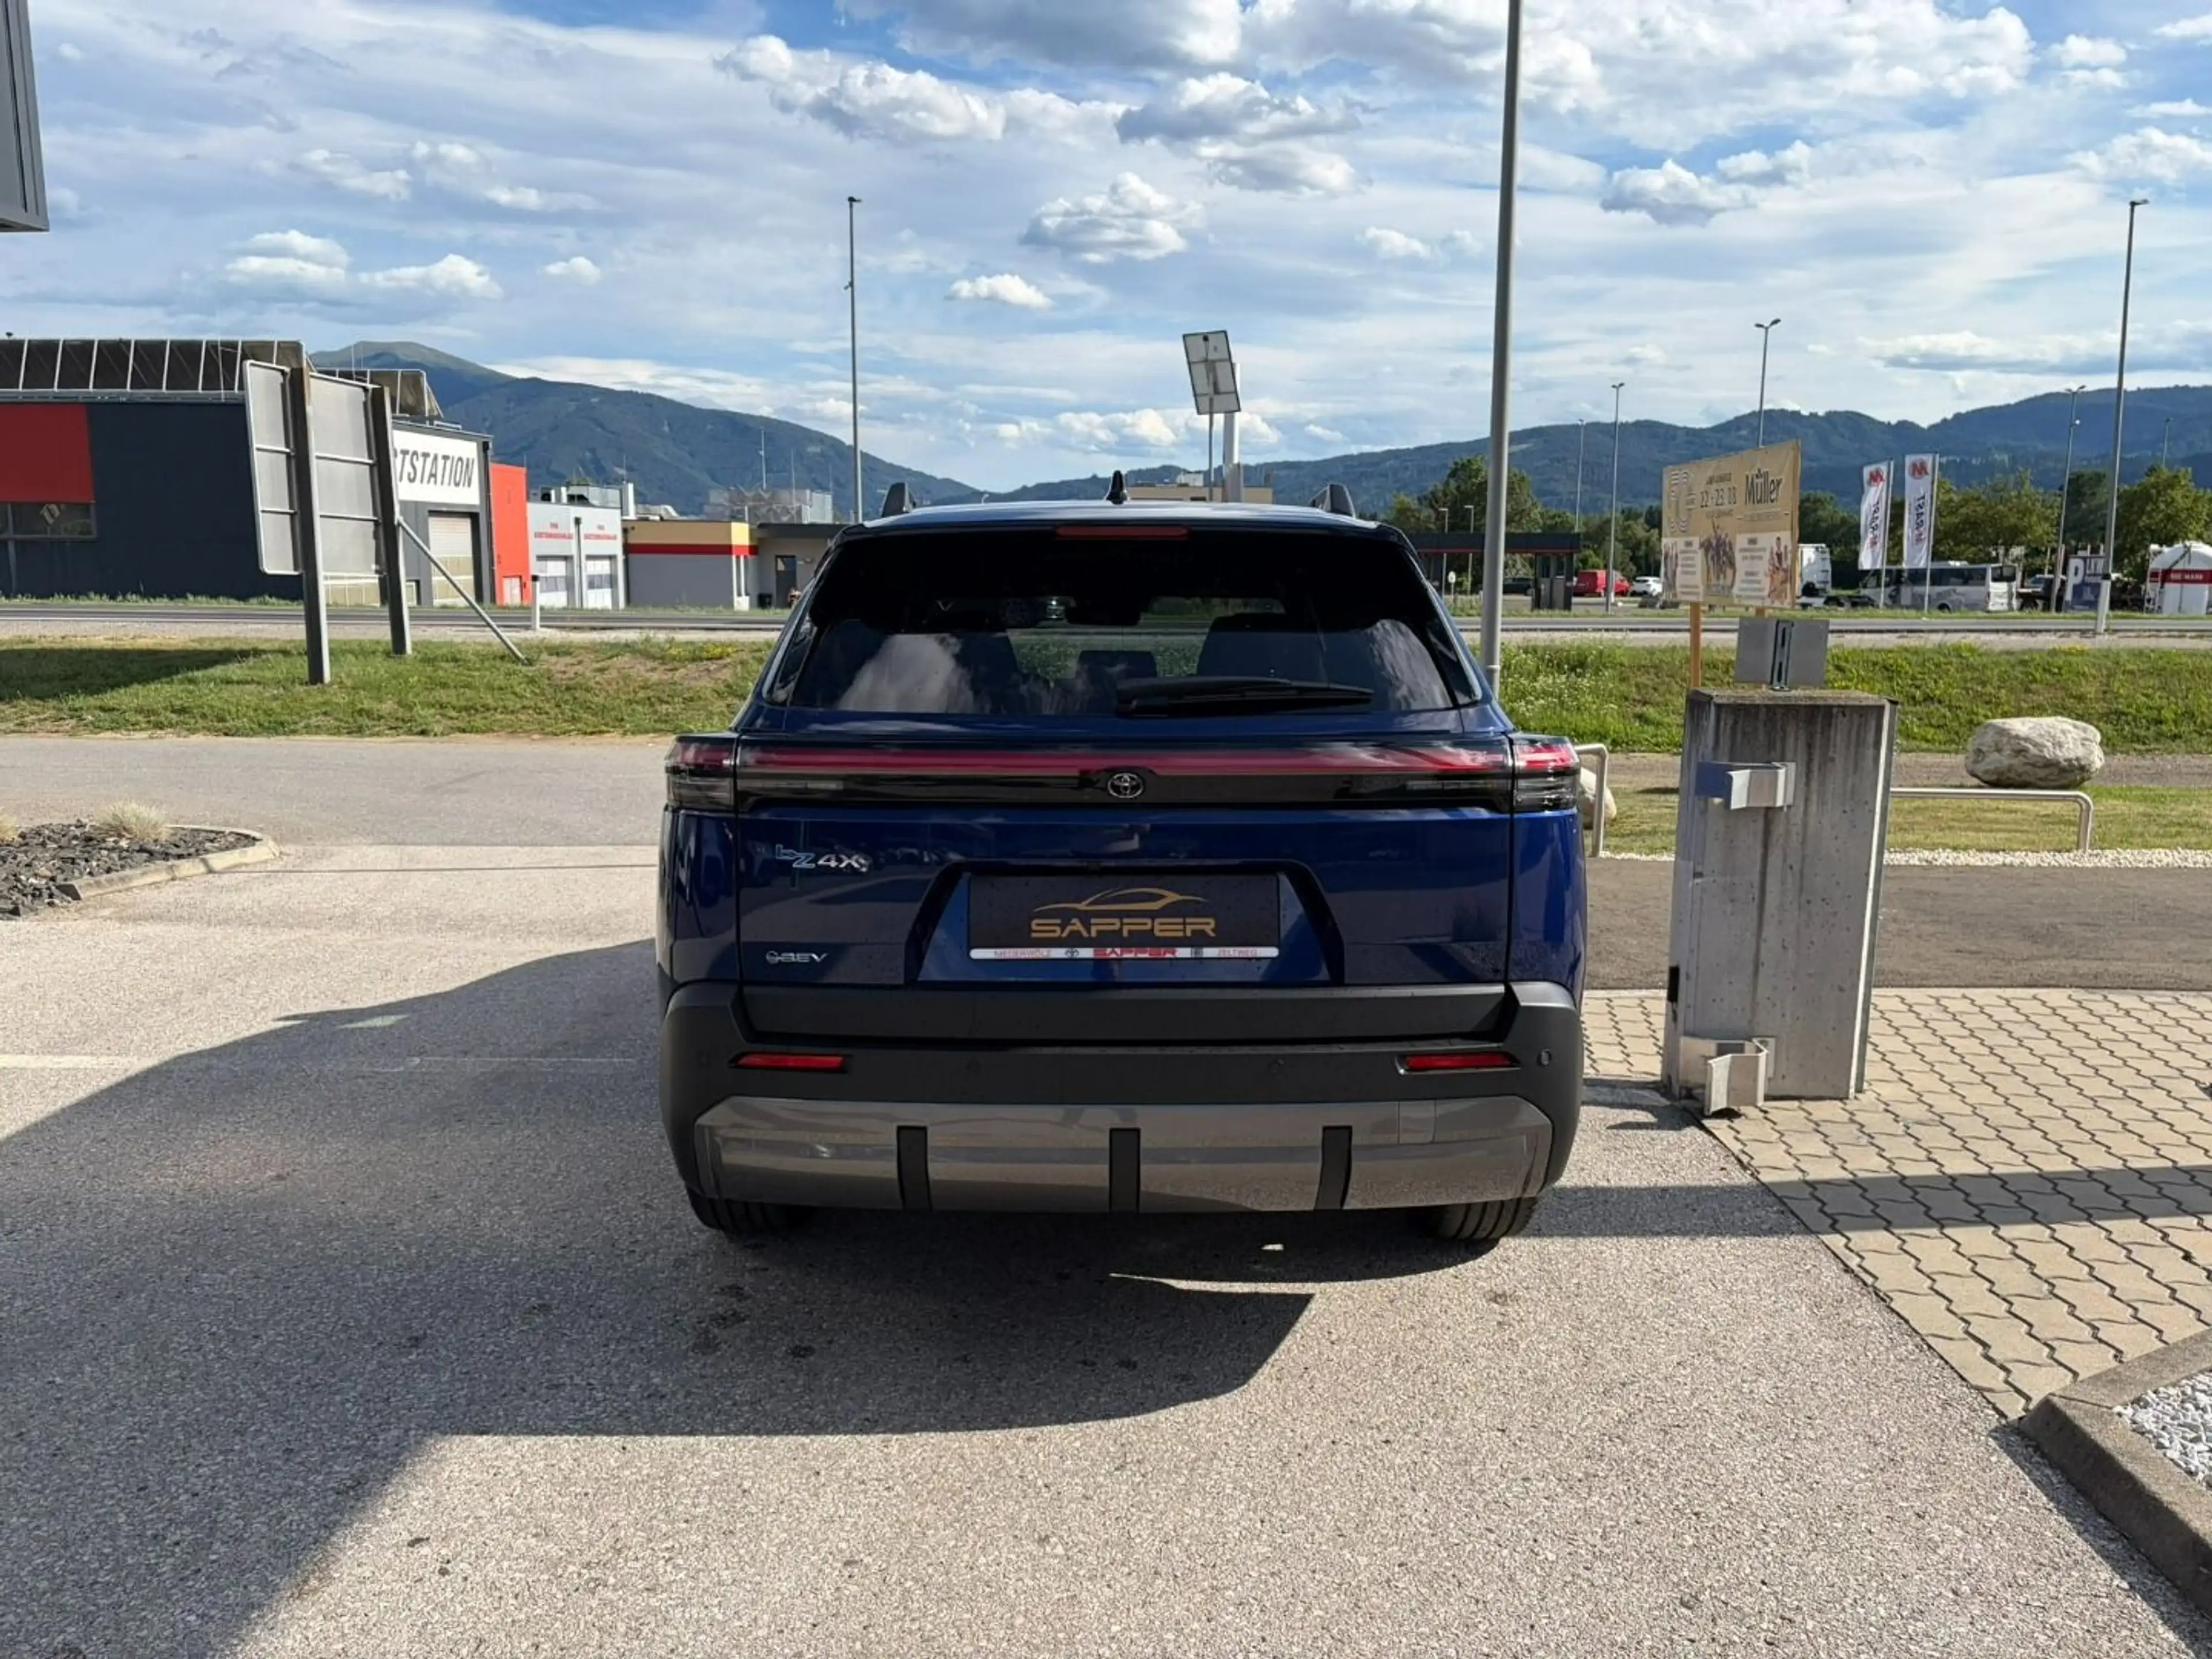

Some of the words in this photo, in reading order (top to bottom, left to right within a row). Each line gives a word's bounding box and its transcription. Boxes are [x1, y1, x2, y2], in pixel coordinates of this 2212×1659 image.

[393, 448, 475, 488] TSTATION
[1745, 468, 1783, 505] Müller
[1031, 918, 1216, 938] SAPPER
[1093, 948, 1179, 959] SAPPER
